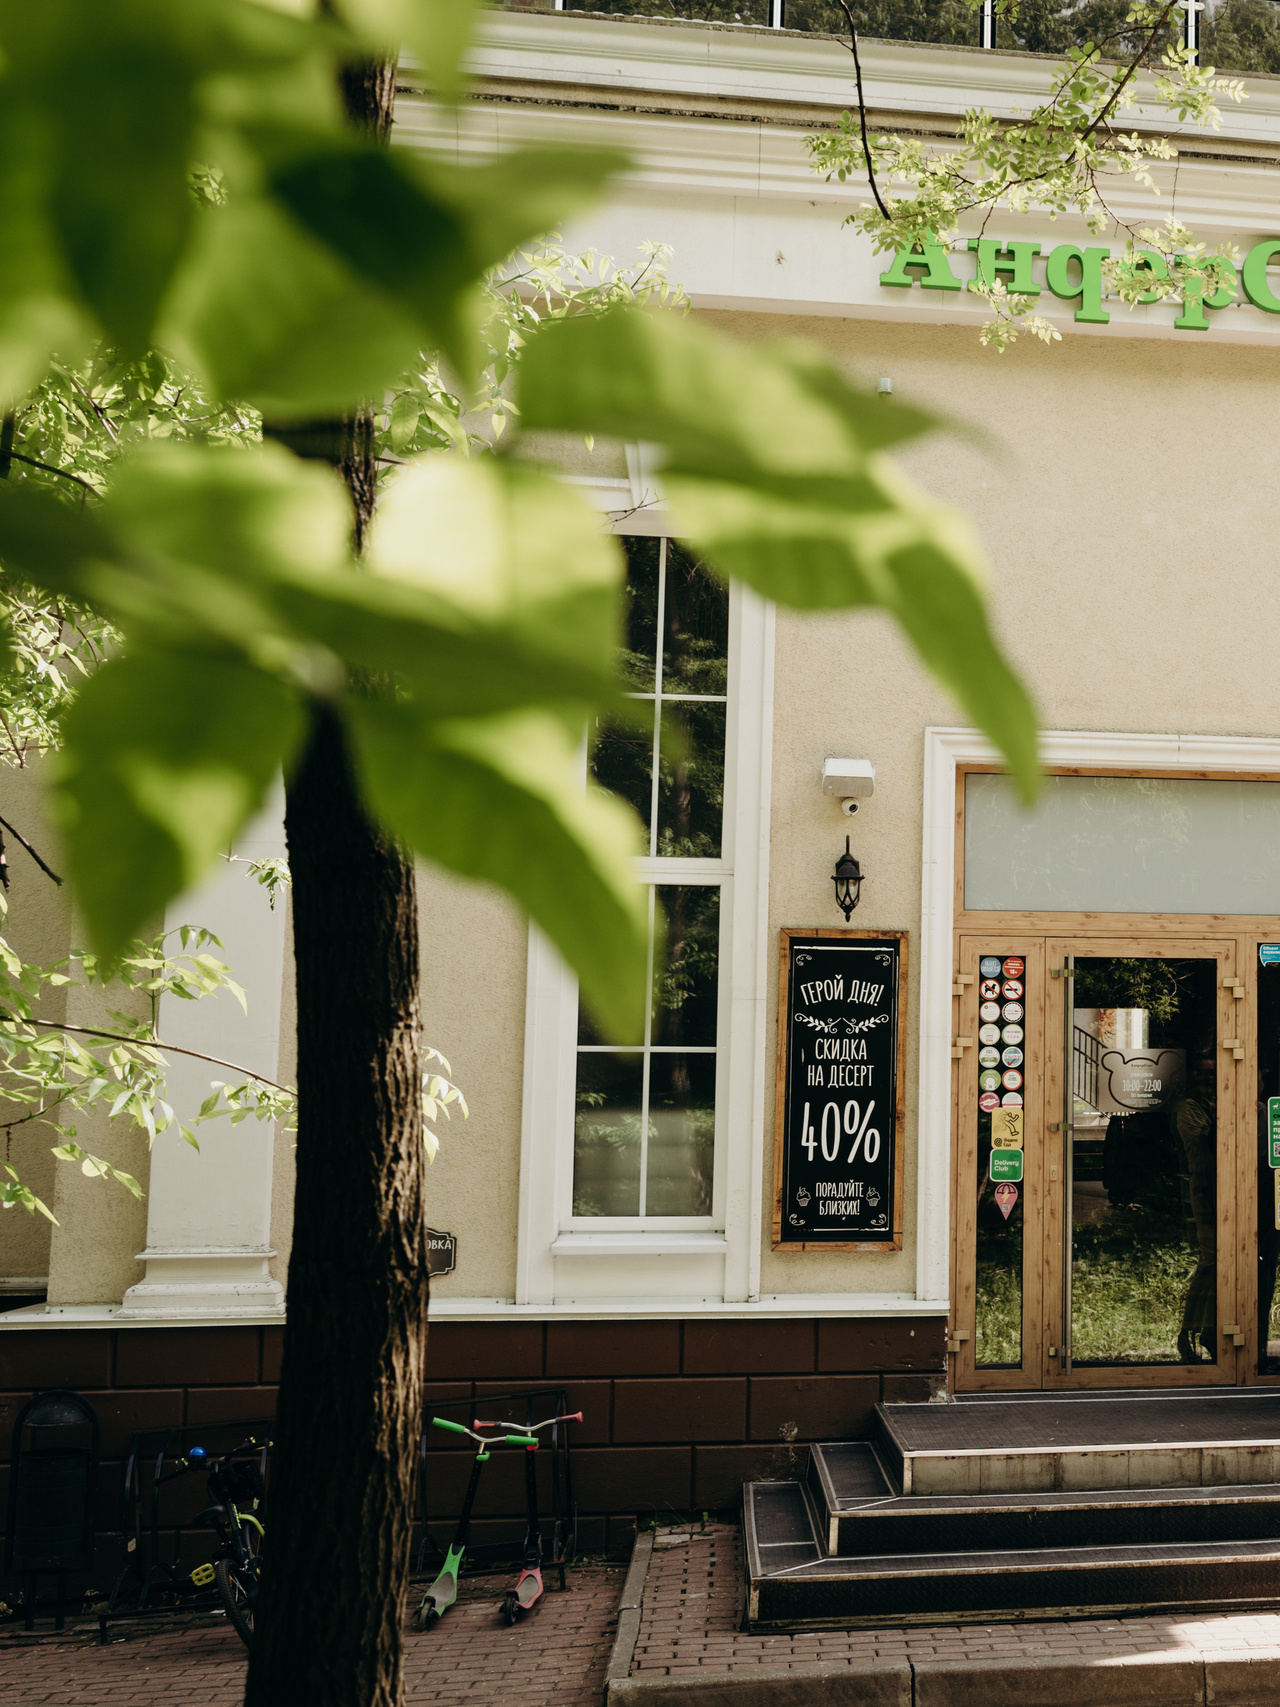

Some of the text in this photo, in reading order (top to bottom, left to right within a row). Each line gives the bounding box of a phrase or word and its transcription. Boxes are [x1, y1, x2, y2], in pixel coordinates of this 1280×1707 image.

[800, 974, 885, 1006] ГЕРОЙ ДНЯ!
[815, 1038, 867, 1062] СКИДКА
[807, 1065, 875, 1088] НА ДЕСЕРТ
[801, 1100, 880, 1163] 40%
[994, 1159, 1019, 1167] Delivery
[815, 1179, 864, 1198] ПОРАДУЙТЕ
[819, 1200, 860, 1215] БЛИЗКИХ!
